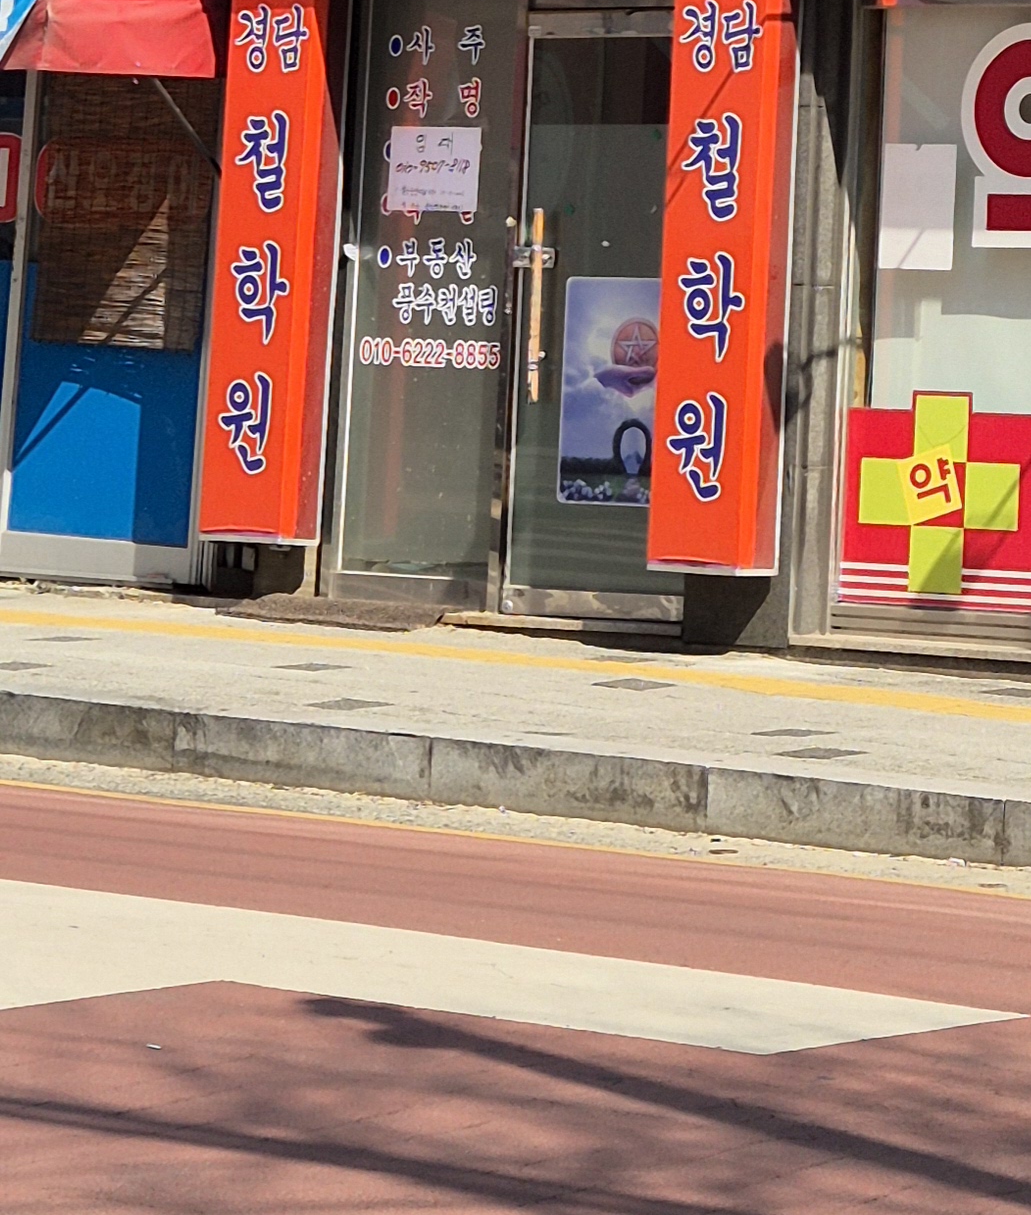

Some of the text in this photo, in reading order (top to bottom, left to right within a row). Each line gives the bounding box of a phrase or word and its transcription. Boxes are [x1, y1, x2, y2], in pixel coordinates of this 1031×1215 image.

[396, 238, 477, 279] 부동산
[360, 336, 500, 370] 010-6222-8855
[909, 457, 954, 504] 약
